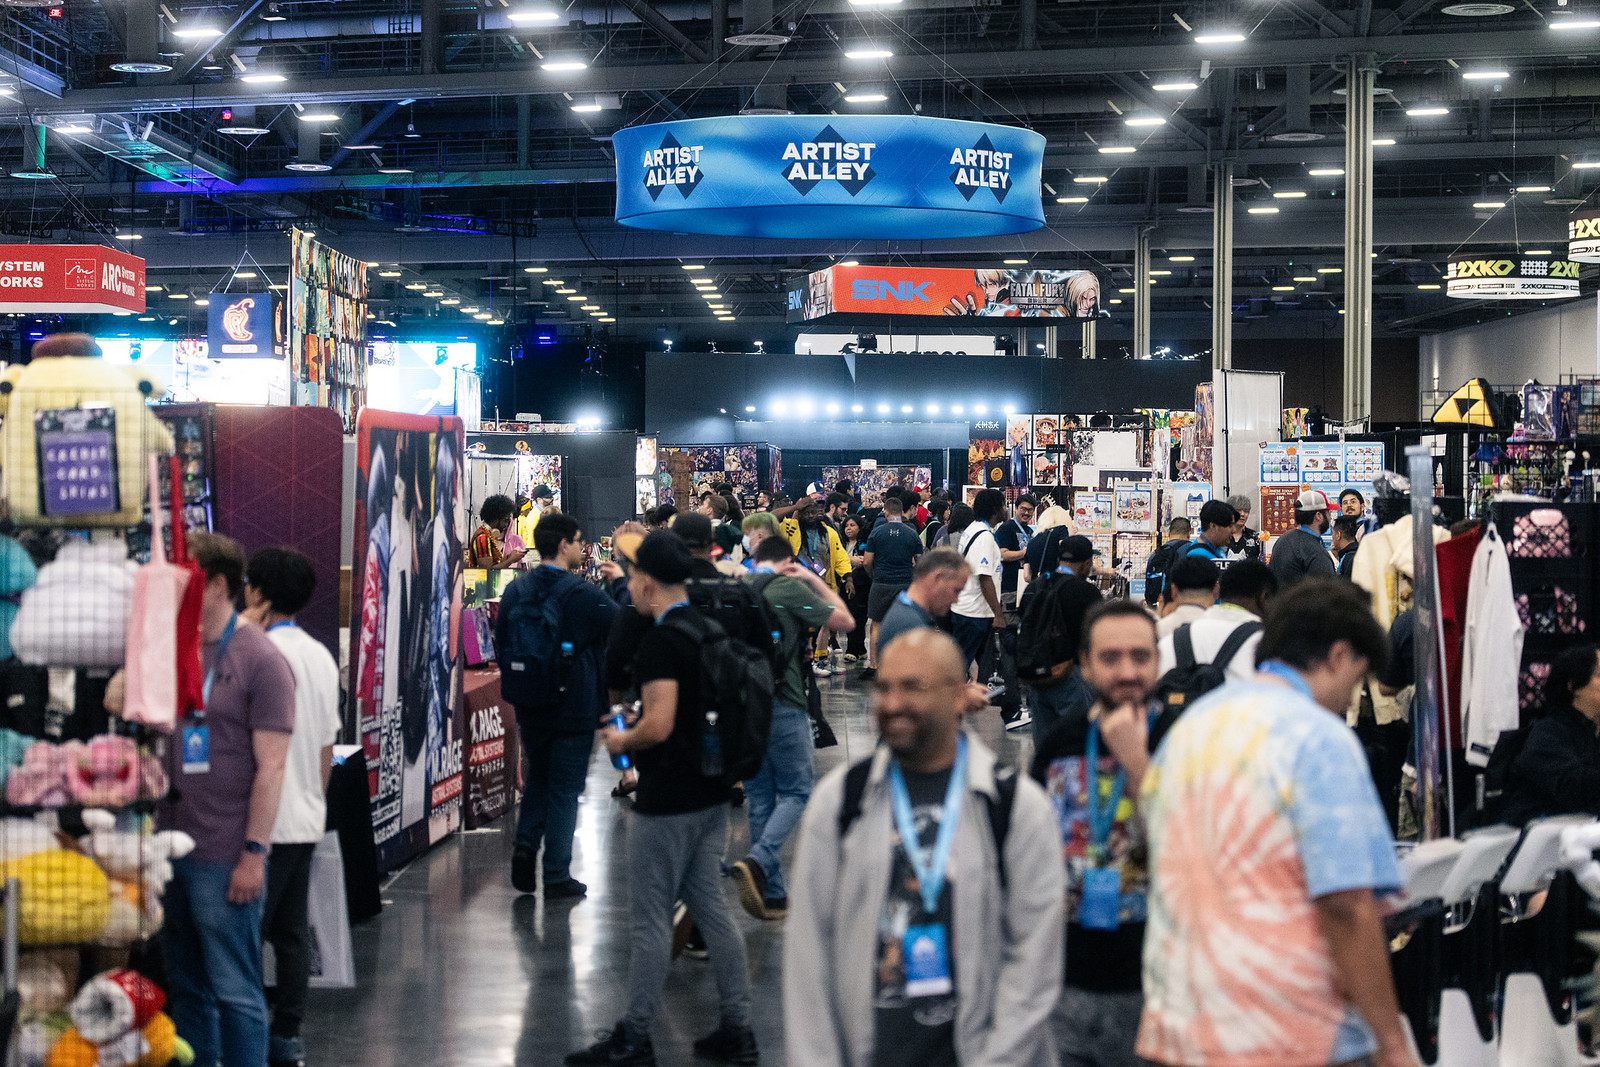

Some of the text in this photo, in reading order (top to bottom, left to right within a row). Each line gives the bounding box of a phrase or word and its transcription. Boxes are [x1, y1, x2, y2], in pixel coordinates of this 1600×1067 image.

[643, 145, 704, 168] ARTIST
[781, 142, 876, 161] ARTIST
[949, 147, 1013, 170] ARTIST
[646, 165, 699, 187] ALLEY
[787, 162, 870, 181] ALLEY
[954, 167, 1009, 189] ALLEY
[101, 262, 122, 293] ARC
[1456, 259, 1516, 278] 2XKO
[851, 279, 932, 302] SNK
[1010, 283, 1065, 297] FATAL FURY
